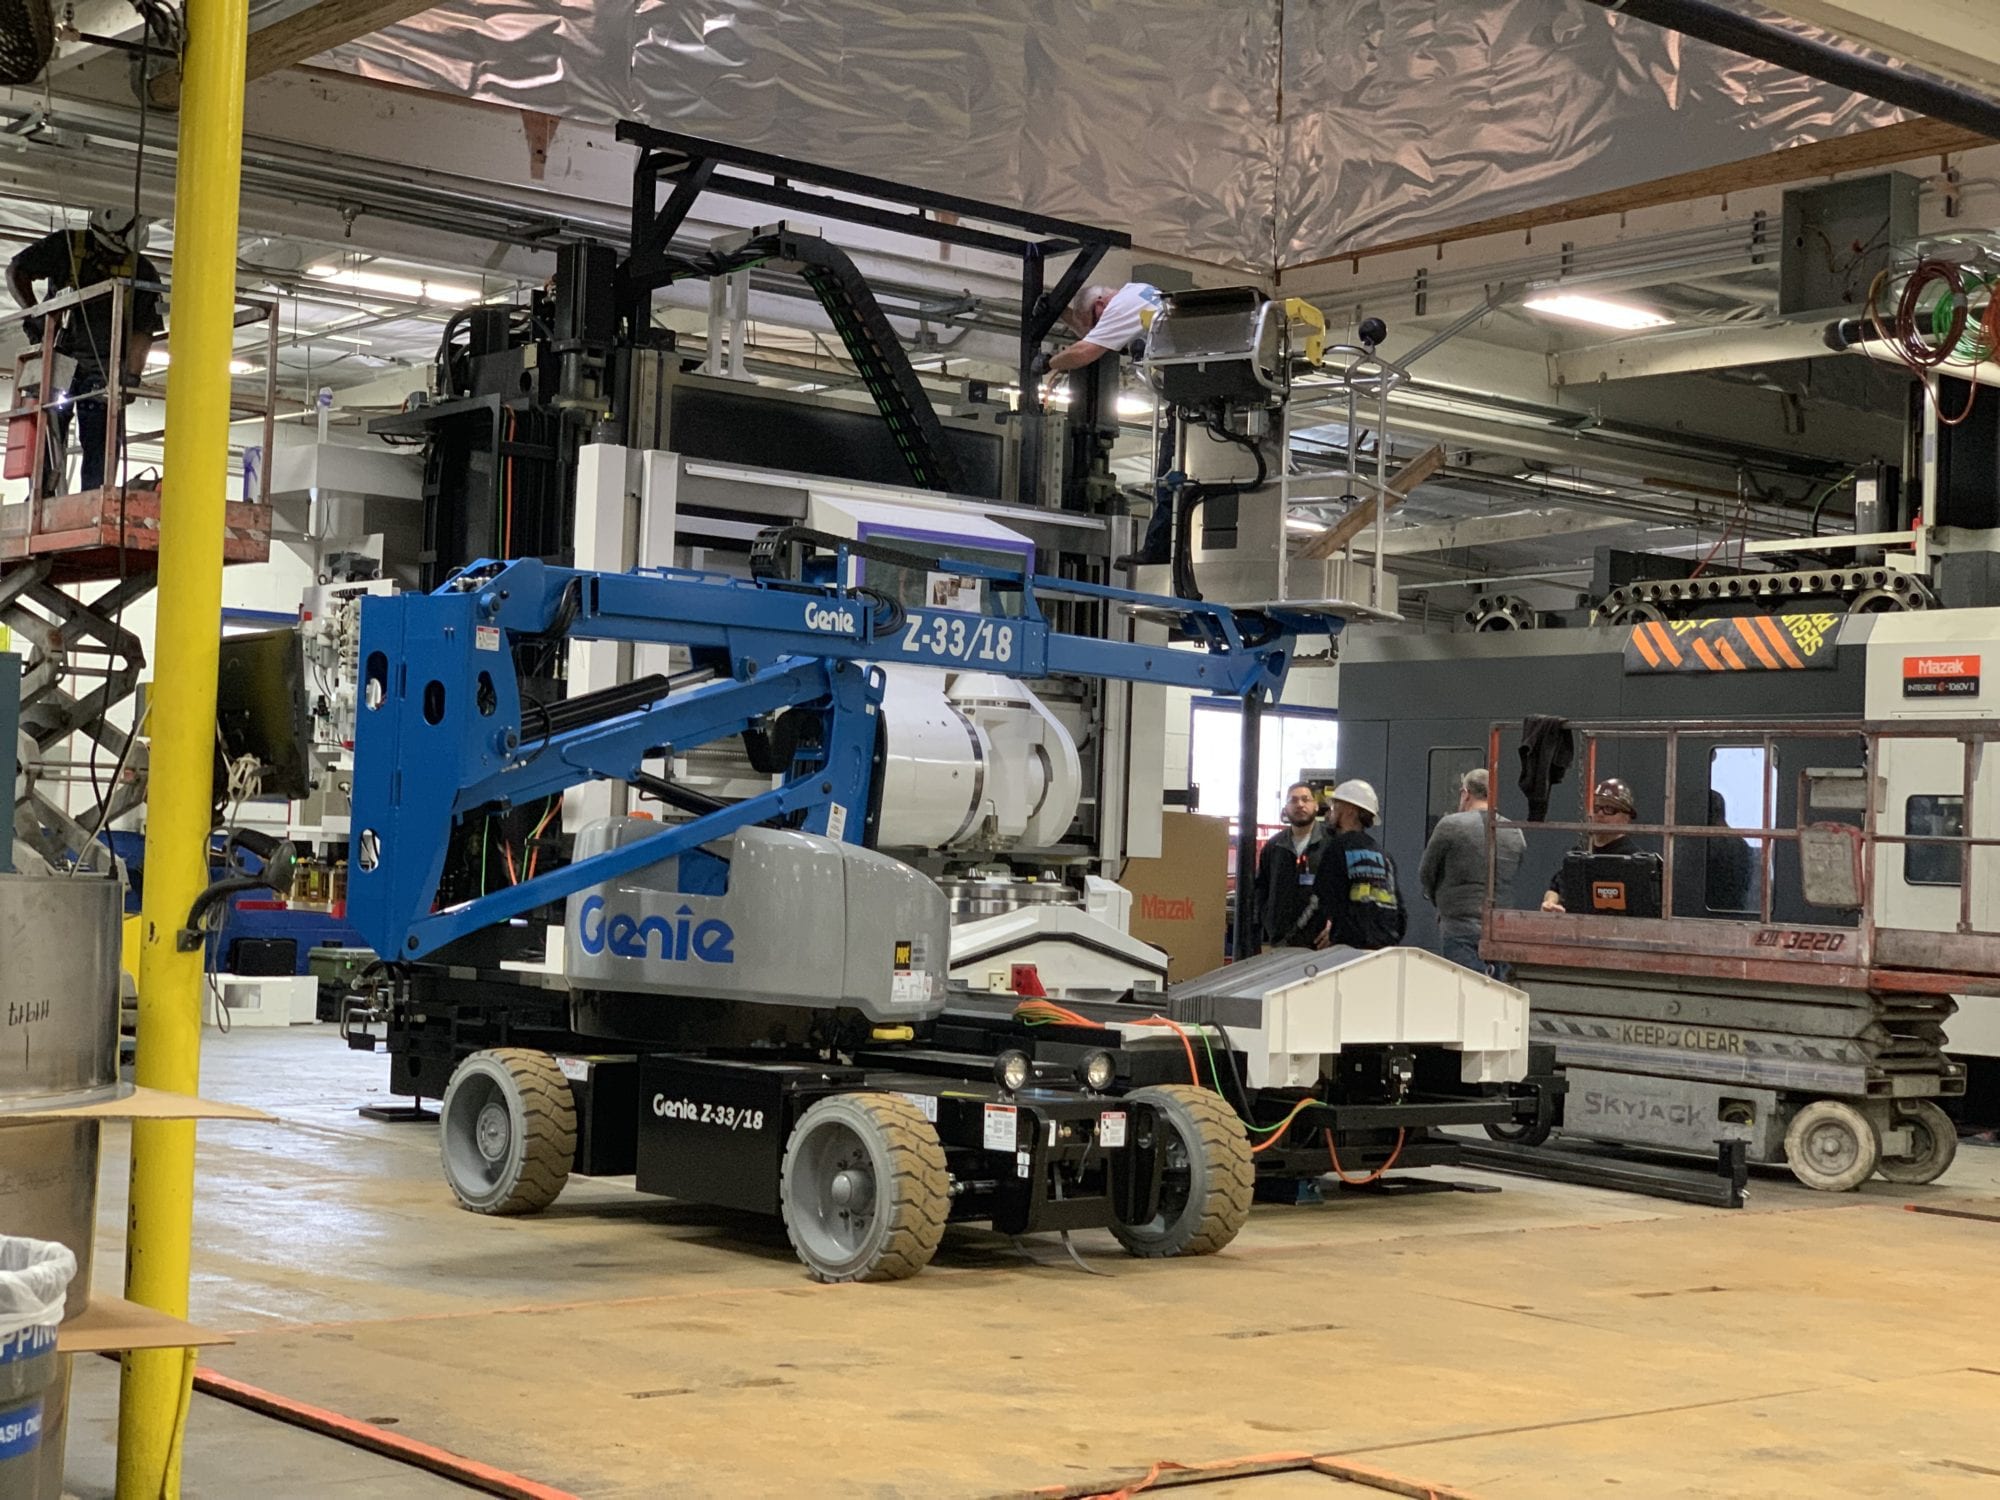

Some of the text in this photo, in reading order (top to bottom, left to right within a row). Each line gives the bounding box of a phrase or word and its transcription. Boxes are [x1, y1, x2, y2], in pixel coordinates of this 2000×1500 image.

[804, 601, 857, 634] Genie
[902, 614, 1013, 663] Z-33/18
[1918, 658, 1966, 675] Mazak
[1141, 894, 1197, 920] Mazak
[579, 894, 735, 964] Genie
[1783, 931, 1846, 952] 3220
[1622, 1024, 1741, 1054] KEEP CLEAR
[652, 1093, 764, 1131] Genie Z-33/18
[1585, 1091, 1704, 1127] SKYJACK
